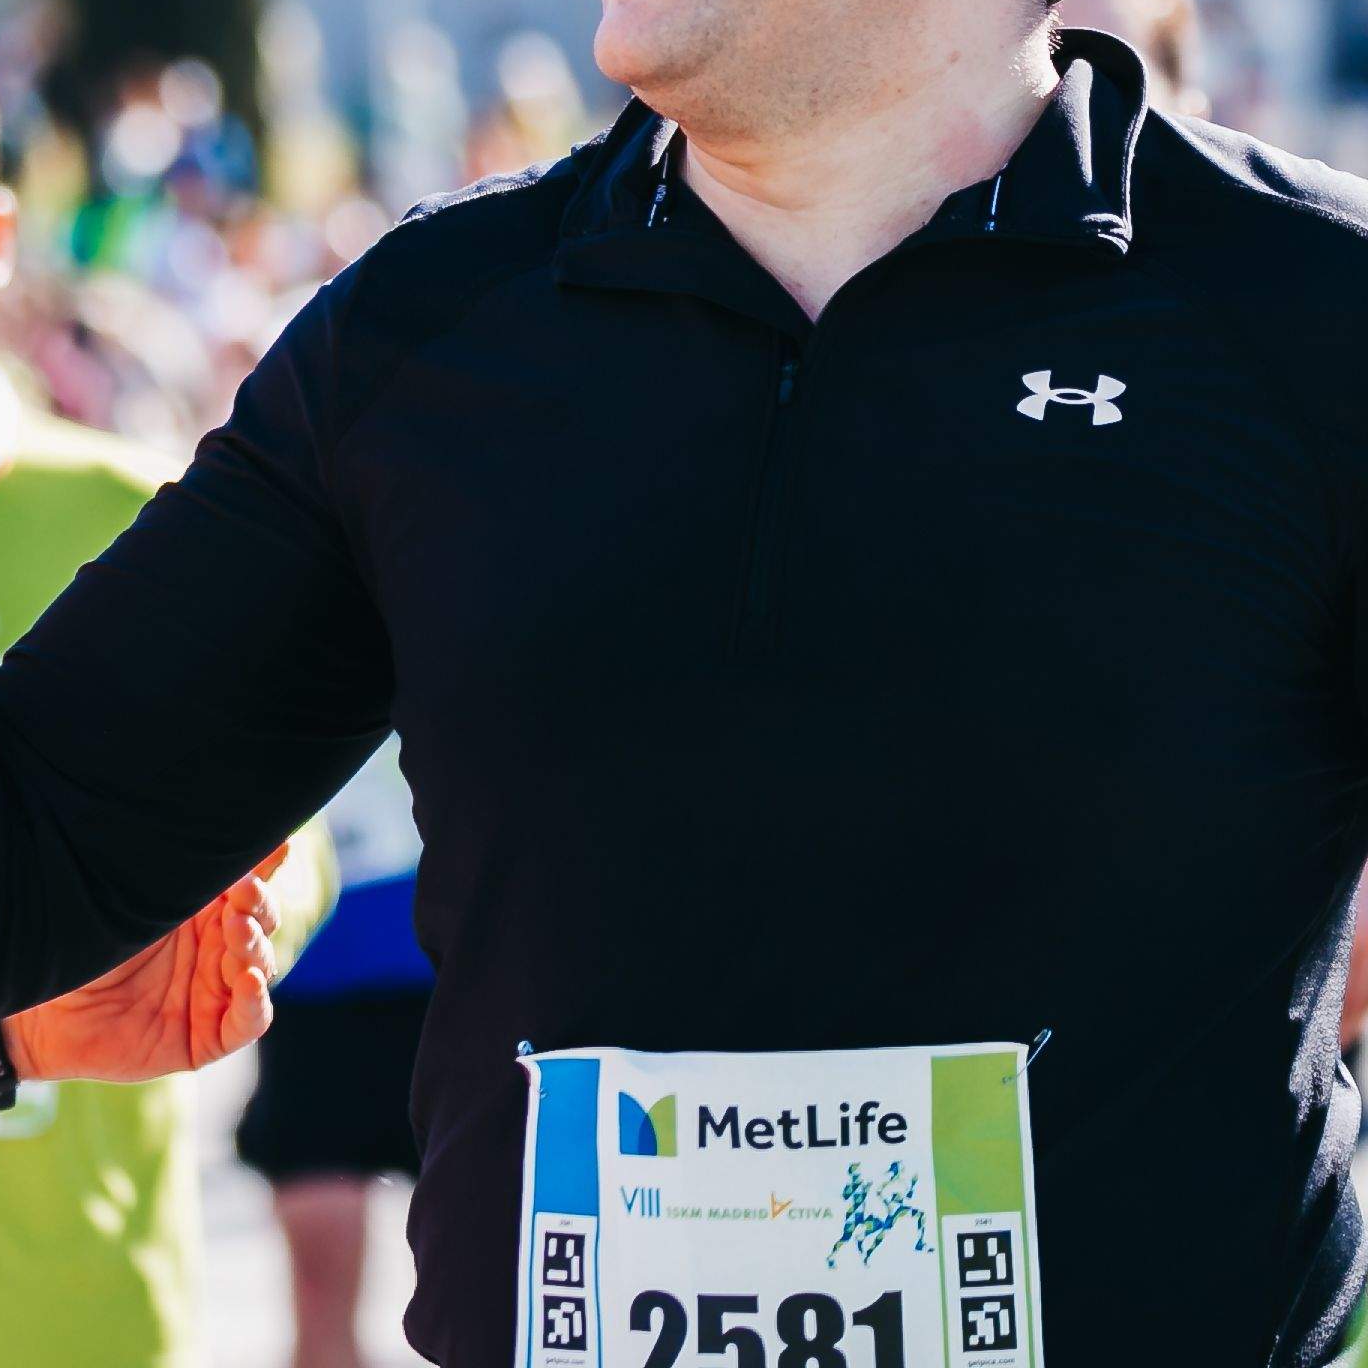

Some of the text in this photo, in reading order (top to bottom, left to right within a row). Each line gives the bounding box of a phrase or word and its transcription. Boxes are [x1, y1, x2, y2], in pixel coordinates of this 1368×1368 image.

[697, 1100, 909, 1150] MetLife
[619, 1185, 662, 1219] VIII
[707, 1206, 768, 1220] MADRID
[629, 1288, 906, 1368] 2581
